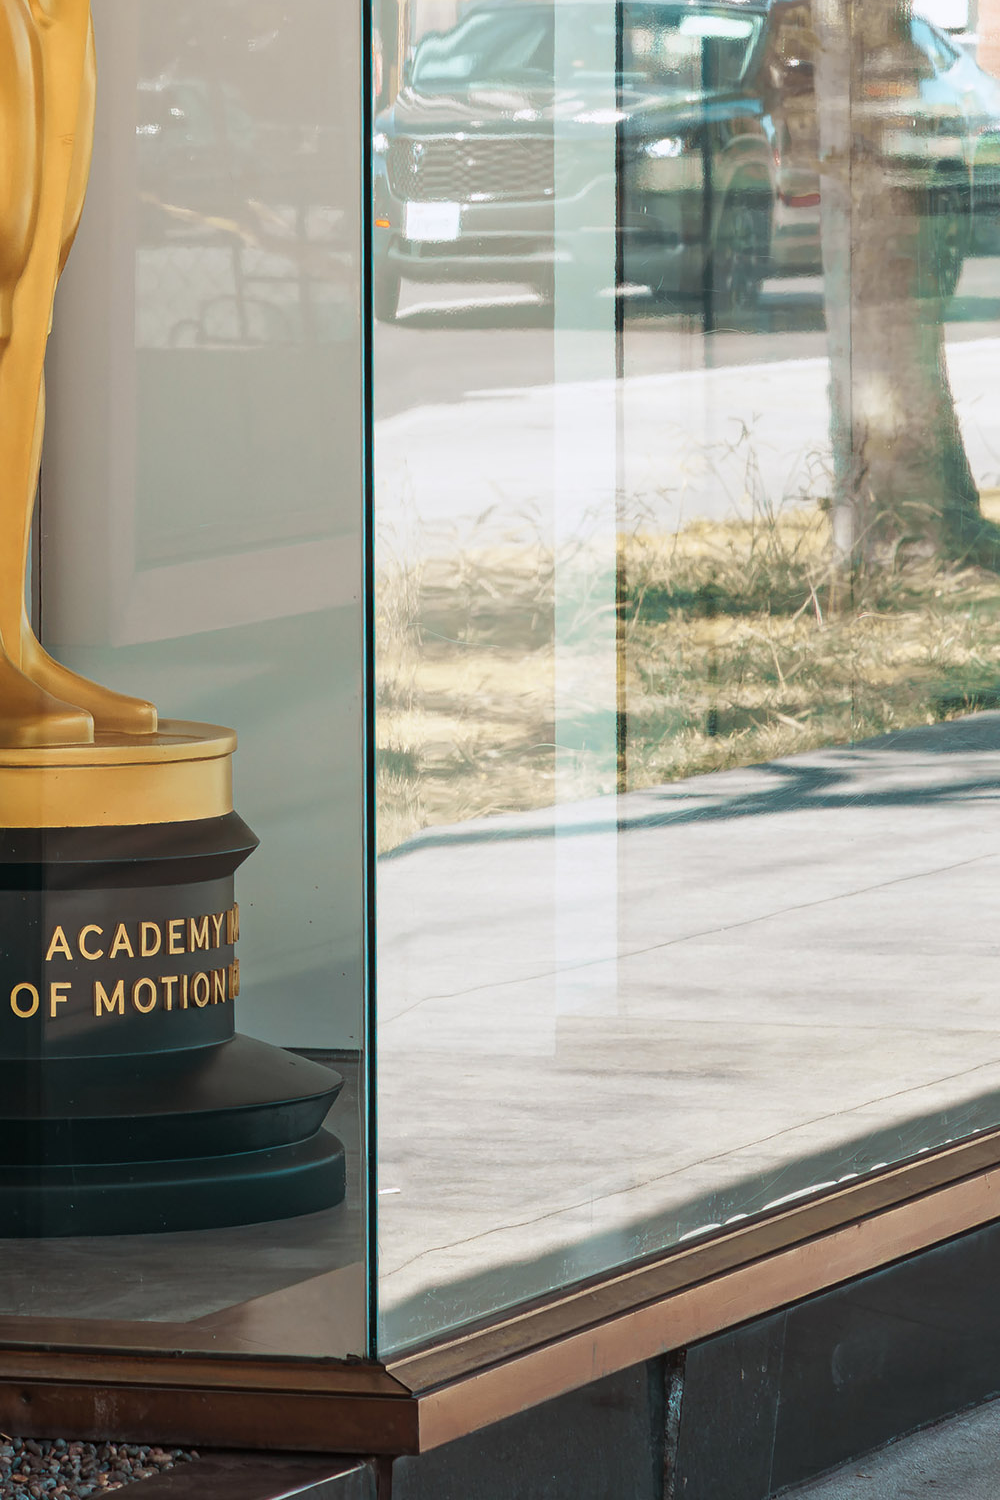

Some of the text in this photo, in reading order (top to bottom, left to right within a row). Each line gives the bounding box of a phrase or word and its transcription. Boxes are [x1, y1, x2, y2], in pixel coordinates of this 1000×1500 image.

[45, 912, 224, 961] ACADEMY
[10, 981, 72, 1018] OF
[93, 968, 226, 1017] MOTION
